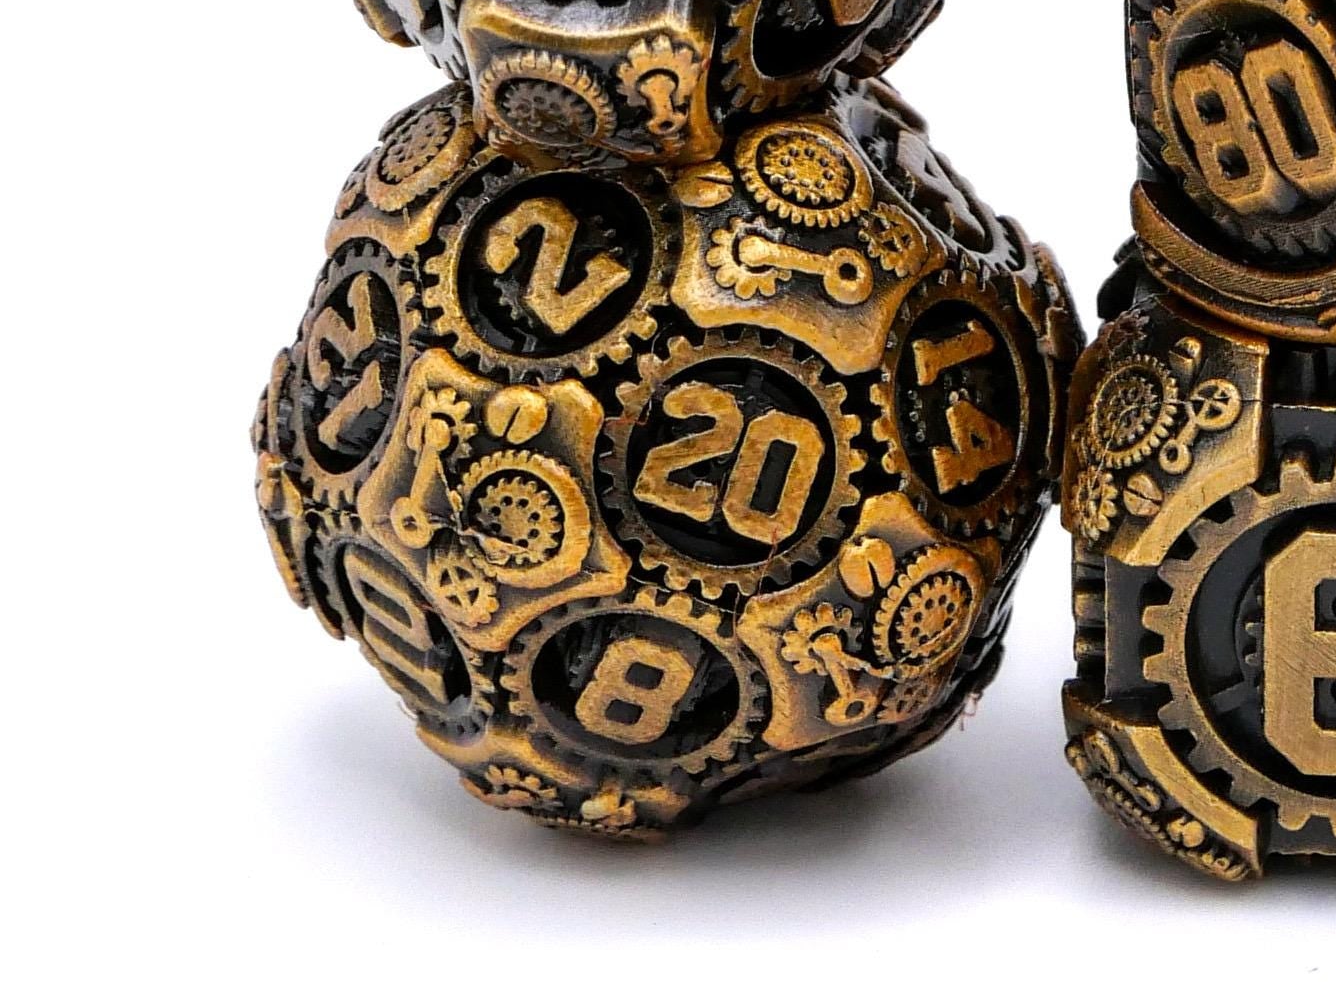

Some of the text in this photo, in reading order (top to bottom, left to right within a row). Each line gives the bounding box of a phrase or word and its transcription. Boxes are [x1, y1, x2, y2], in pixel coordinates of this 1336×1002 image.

[483, 198, 630, 335] 2
[633, 382, 826, 544] 20
[911, 320, 1013, 496] 14
[575, 637, 695, 745] 8
